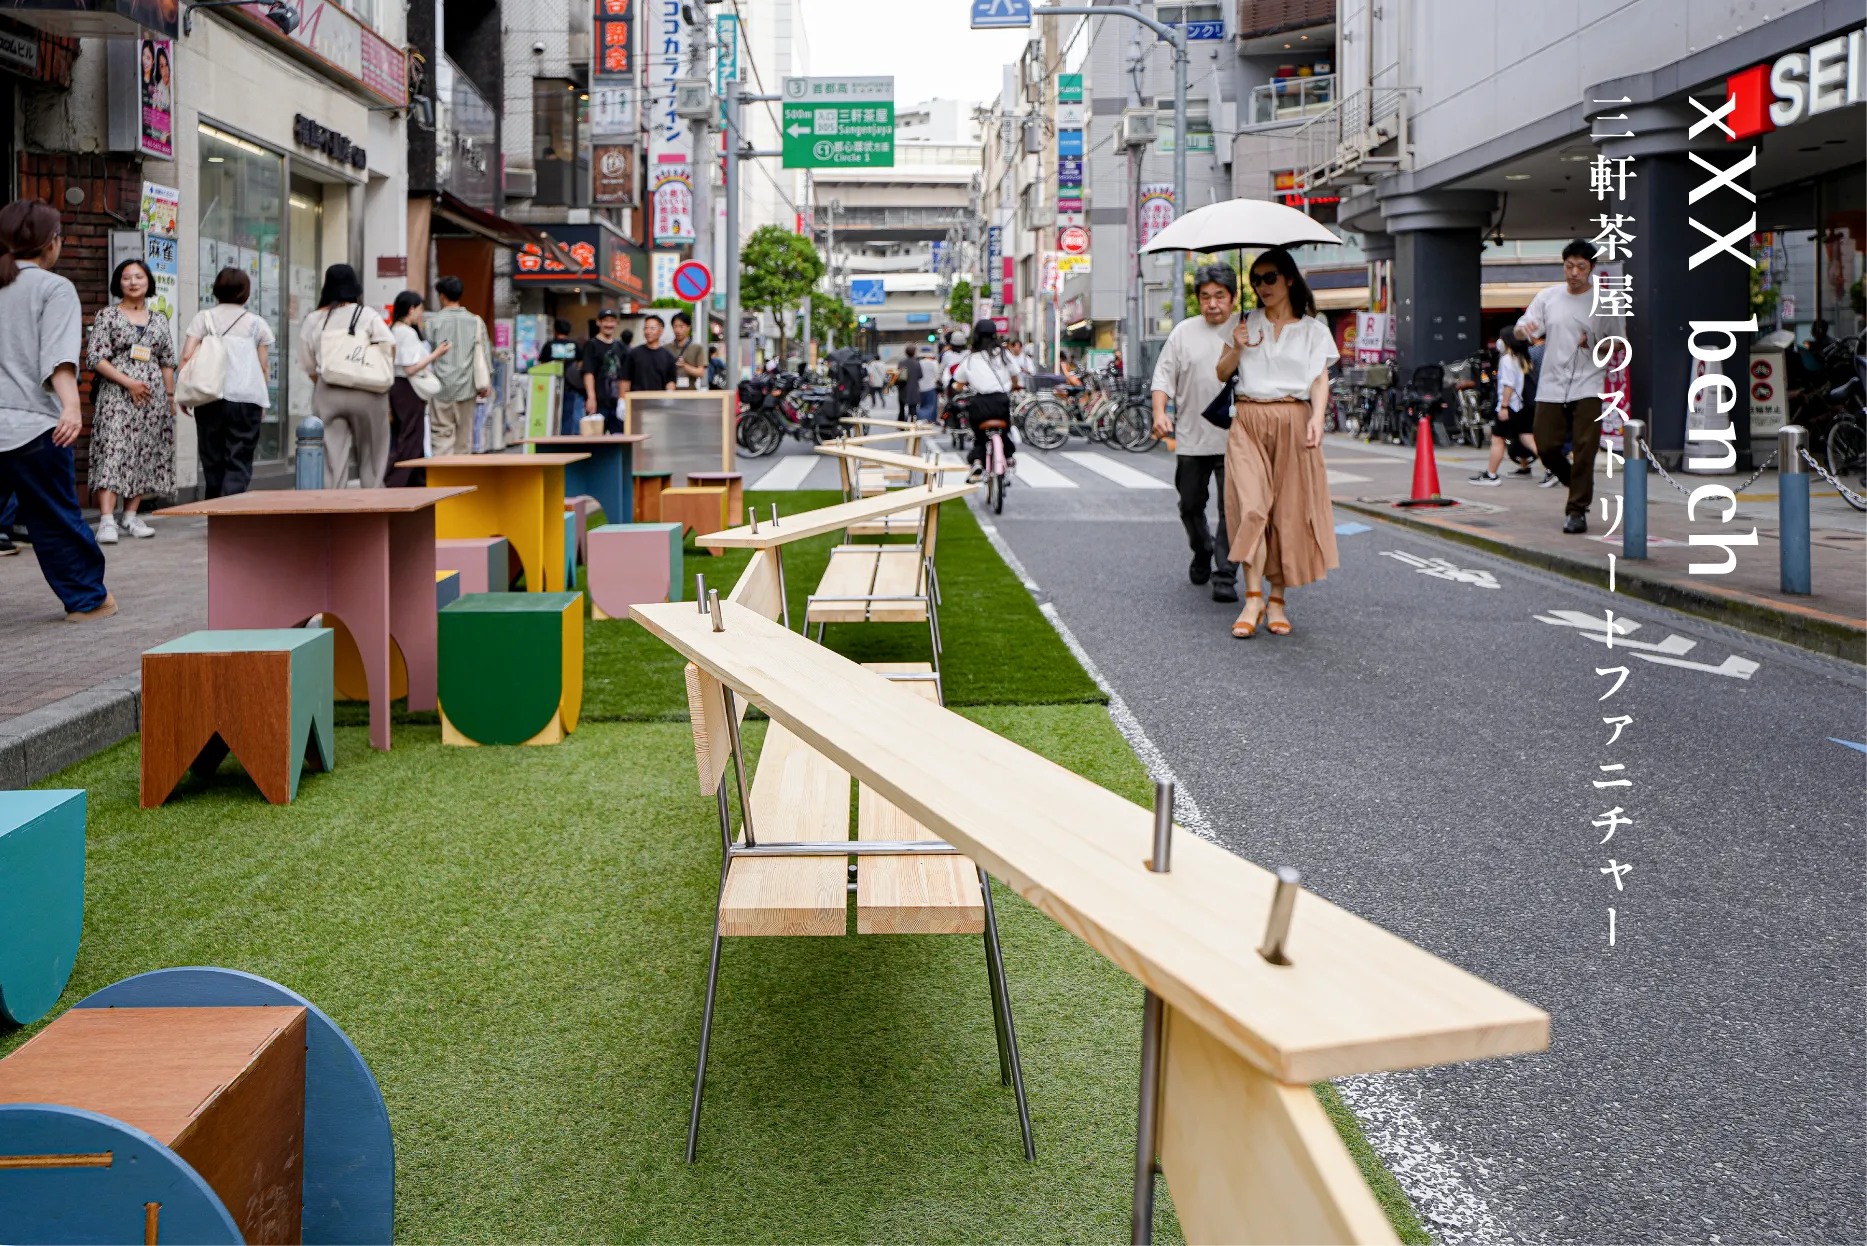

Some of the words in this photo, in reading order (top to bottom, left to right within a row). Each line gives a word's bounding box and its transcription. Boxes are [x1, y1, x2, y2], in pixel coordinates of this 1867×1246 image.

[793, 82, 801, 94] 3
[813, 83, 848, 94] 首都高
[785, 109, 812, 119] 500m
[817, 112, 836, 121] 入口
[838, 108, 888, 123] 三軒茶屋
[838, 124, 892, 137] Sangenjaya
[834, 152, 862, 162] Circle
[863, 152, 871, 162] 1
[148, 239, 174, 263] 麻雀
[1366, 316, 1375, 332] R
